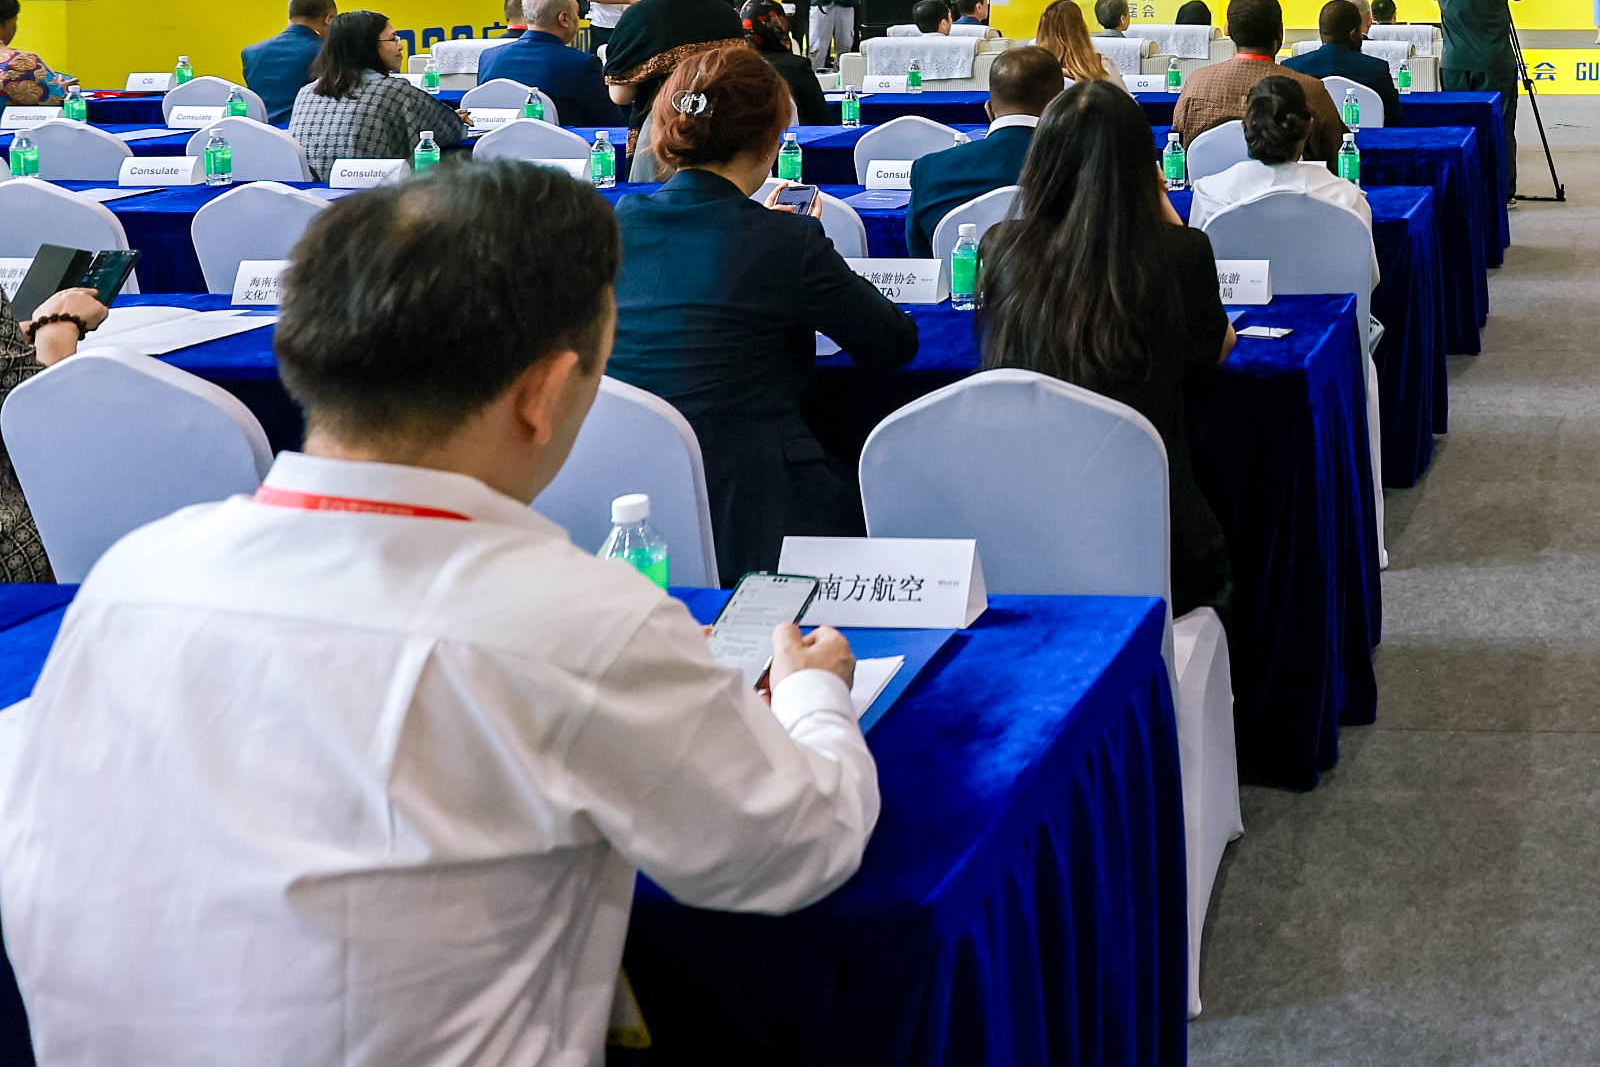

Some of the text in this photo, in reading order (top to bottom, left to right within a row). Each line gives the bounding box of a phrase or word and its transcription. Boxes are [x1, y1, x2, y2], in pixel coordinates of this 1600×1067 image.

[142, 77, 154, 85] CG
[879, 81, 890, 89] CG
[1137, 80, 1149, 88] CG
[9, 113, 47, 121] Consulate
[176, 113, 212, 121] Consulate
[130, 166, 180, 176] Consulate
[340, 168, 387, 178] Consulate
[817, 573, 925, 602] 南方航空
